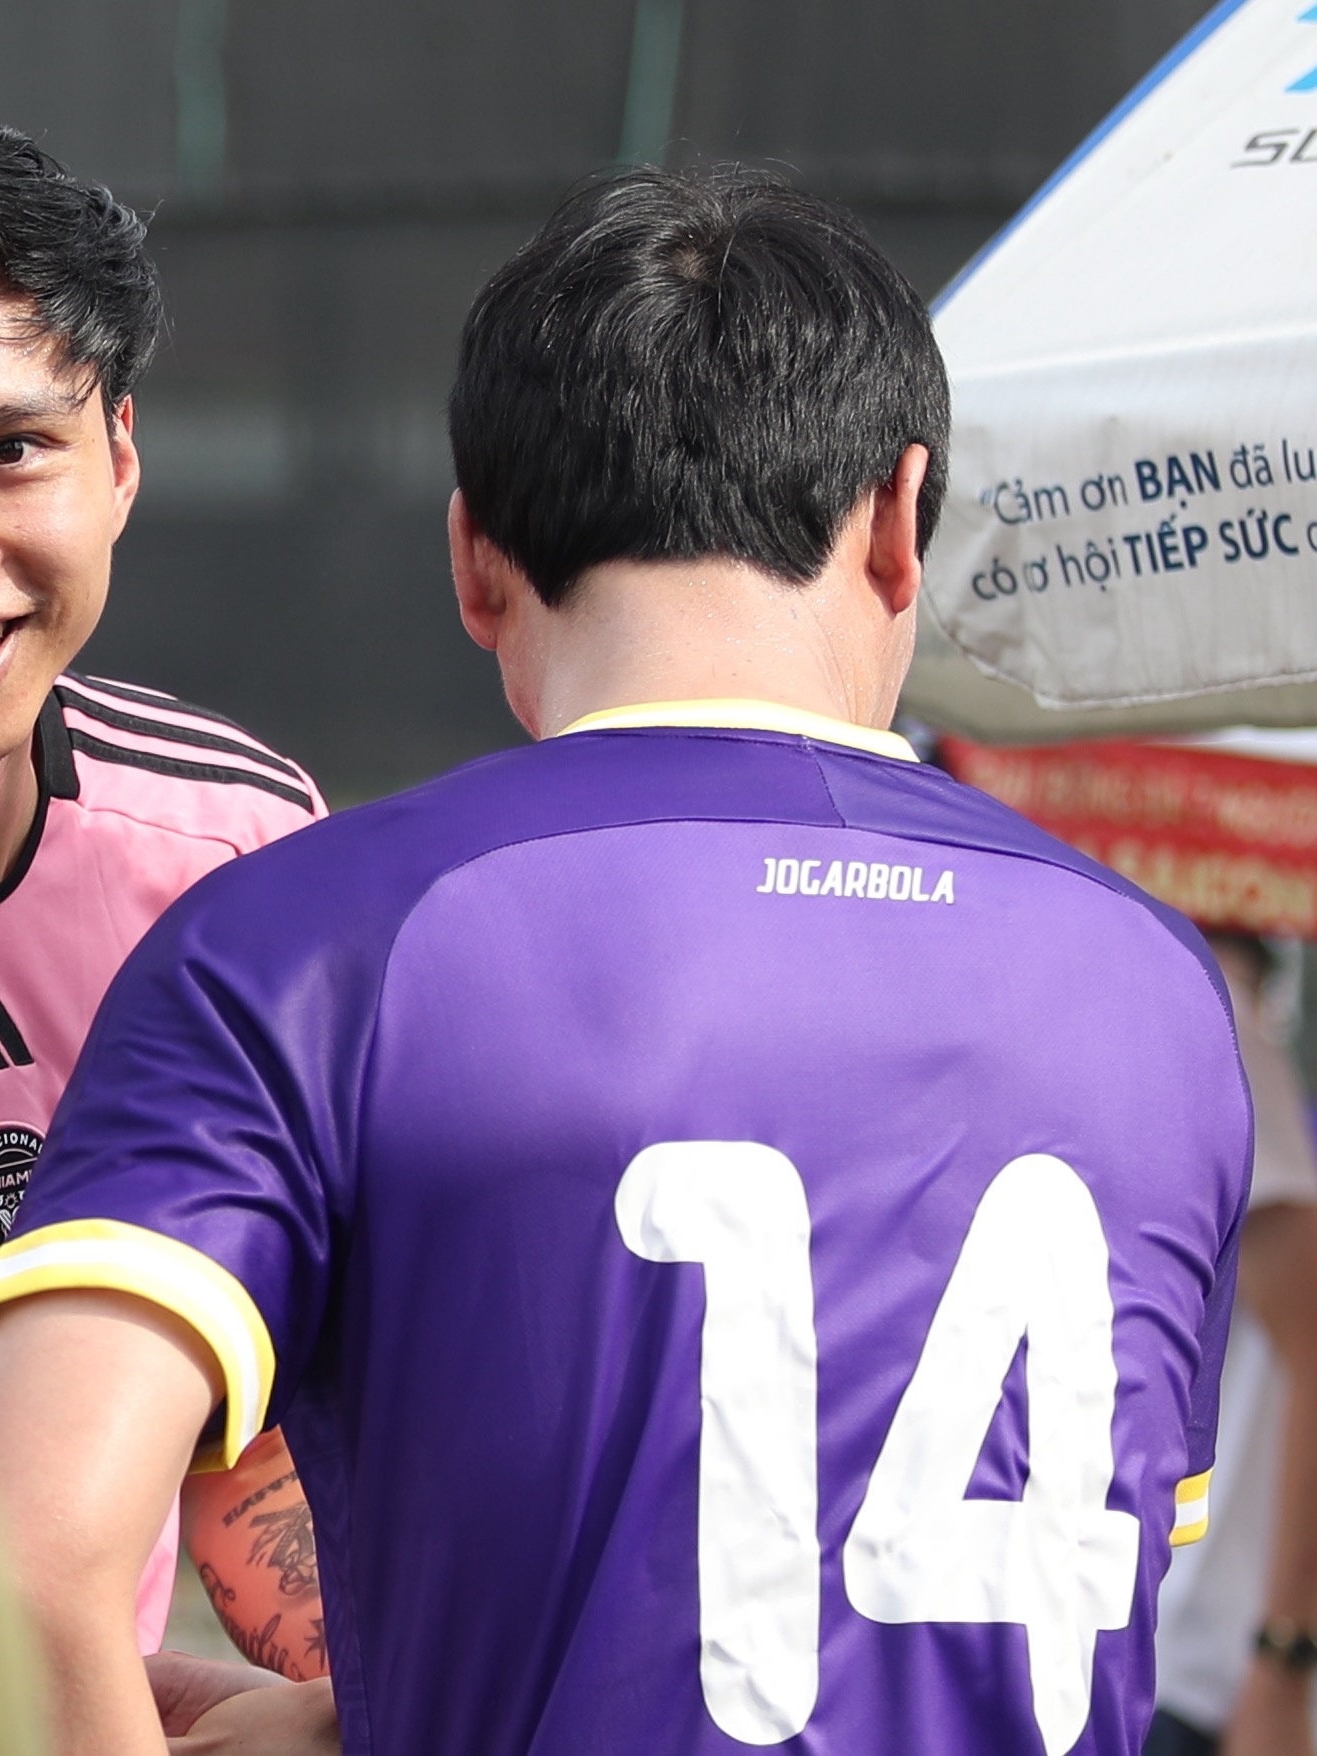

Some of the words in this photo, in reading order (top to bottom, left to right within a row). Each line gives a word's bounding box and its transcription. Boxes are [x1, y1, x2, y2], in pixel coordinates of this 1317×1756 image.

[1081, 473, 1128, 511] ơn
[1134, 451, 1221, 508] BẠN
[1230, 443, 1274, 489] đã
[971, 556, 1018, 600] có
[1056, 537, 1121, 592] hội
[1122, 513, 1208, 576] TIẾP
[1219, 508, 1300, 563] SỨC
[755, 857, 955, 905] JOGARBOLA
[614, 1140, 1140, 1756] 14
